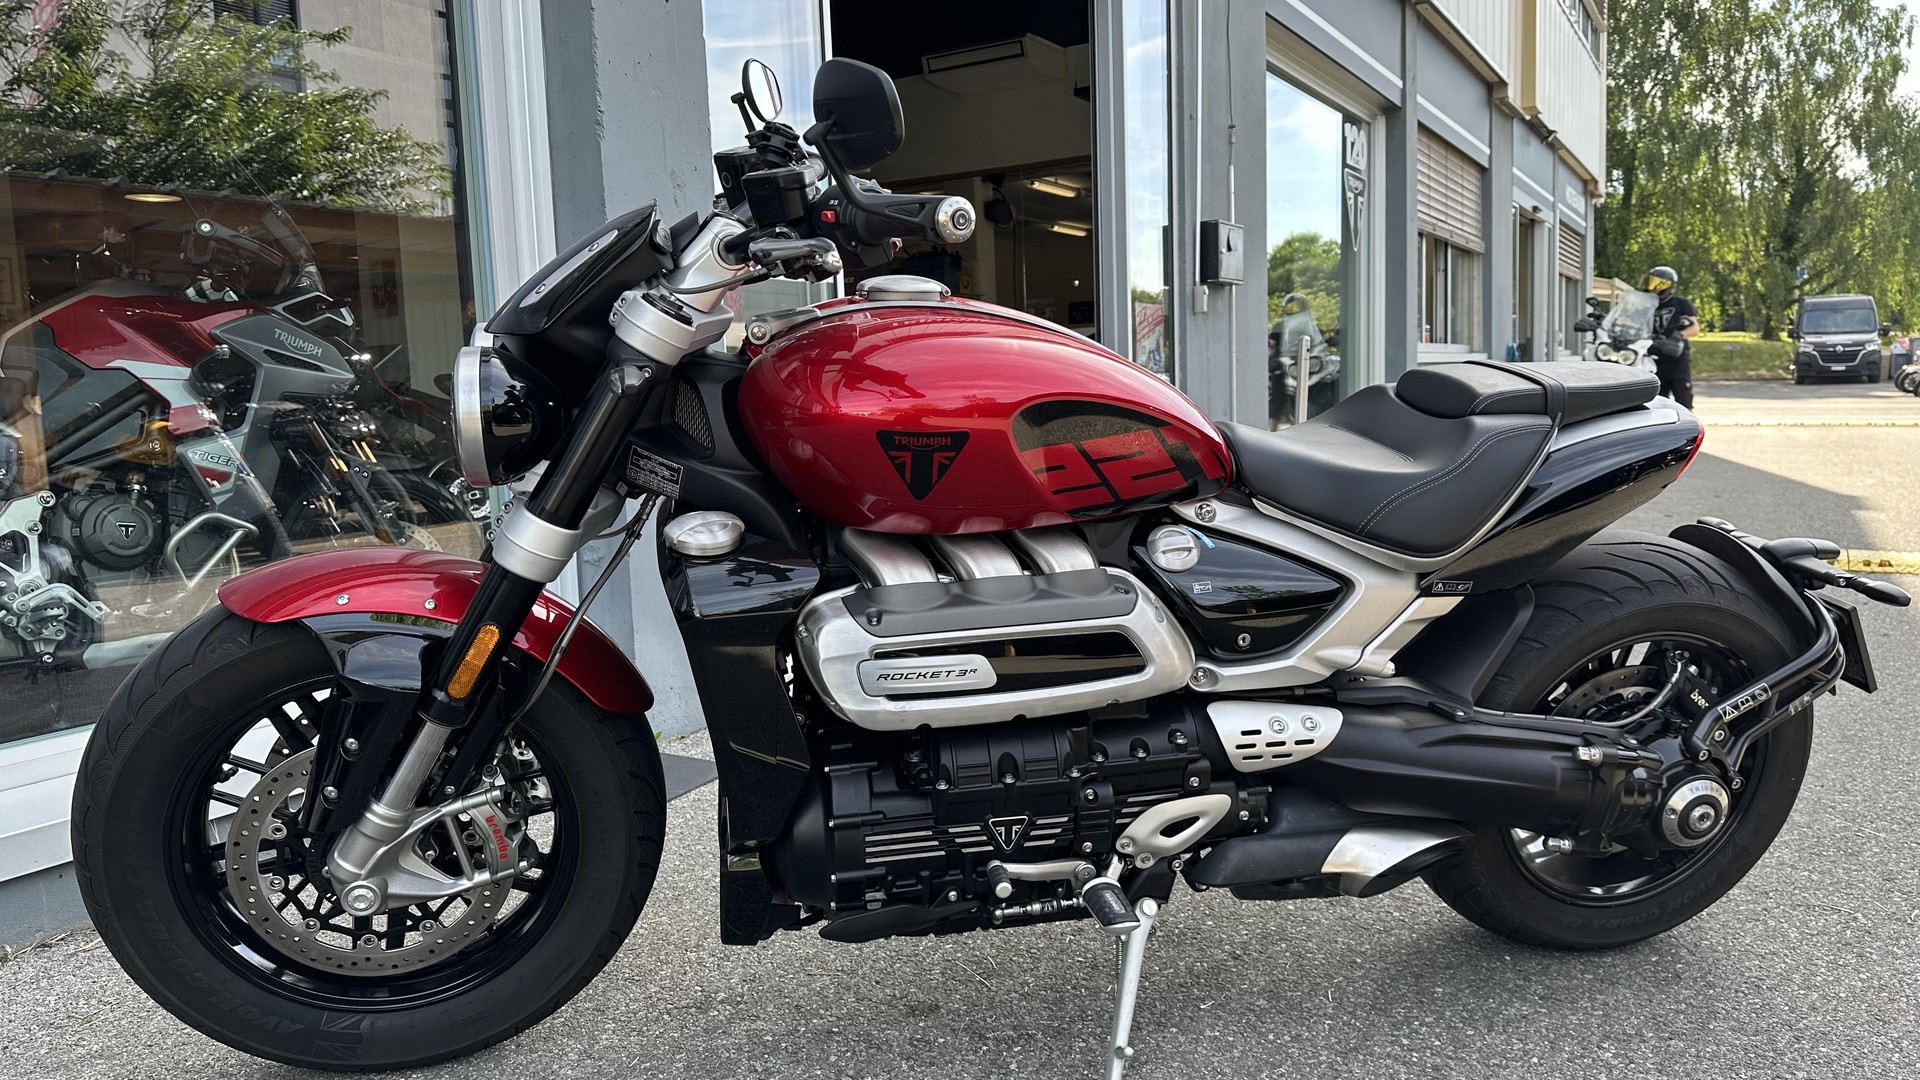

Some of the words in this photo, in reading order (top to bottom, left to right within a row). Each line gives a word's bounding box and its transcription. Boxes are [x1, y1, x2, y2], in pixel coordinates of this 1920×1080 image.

[1344, 123, 1368, 170] 120
[274, 328, 323, 358] TRIUMPH
[893, 436, 951, 446] TRIUMPH
[193, 450, 240, 468] TIGER
[485, 815, 509, 861] brembo
[208, 993, 305, 1033] AVON
